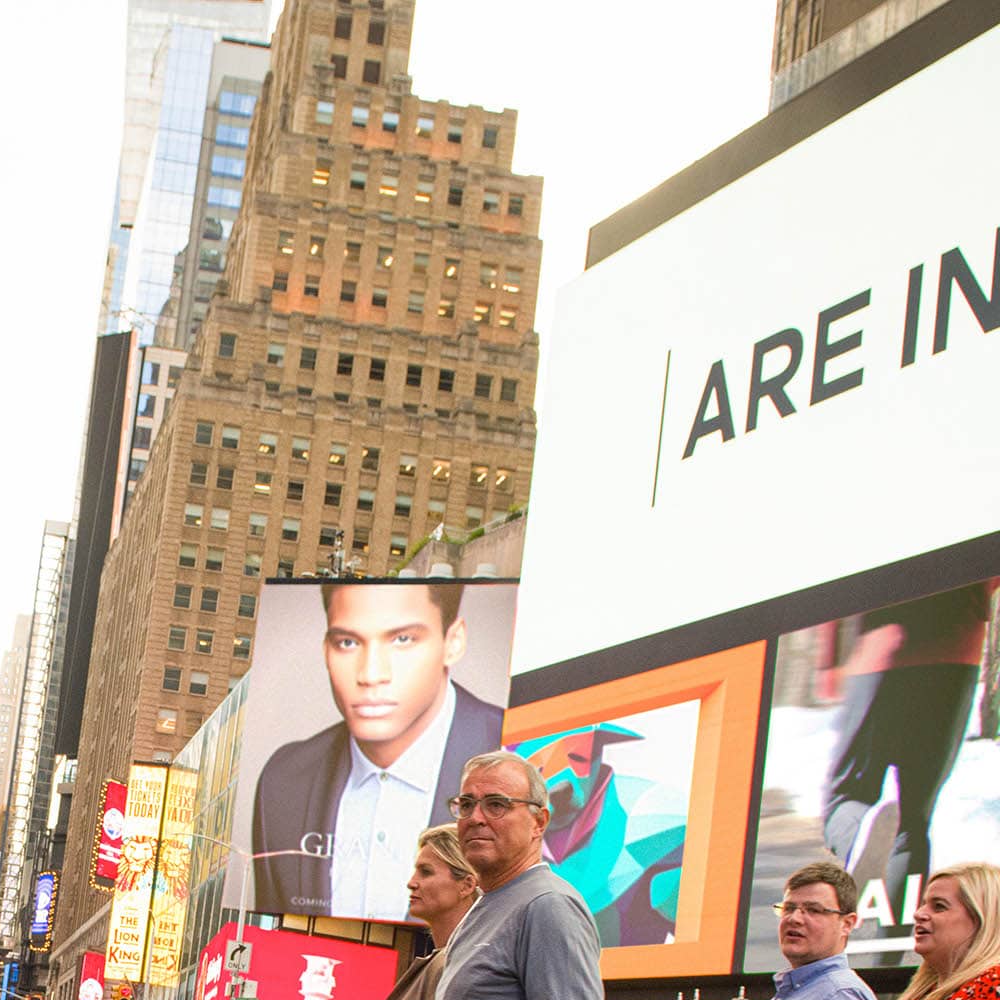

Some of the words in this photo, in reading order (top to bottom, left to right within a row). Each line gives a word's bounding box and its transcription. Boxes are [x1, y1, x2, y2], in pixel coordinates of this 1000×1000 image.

[681, 288, 872, 461] ARE
[128, 801, 160, 819] TODAY
[120, 915, 139, 926] THE
[113, 928, 140, 944] LION
[108, 945, 140, 964] KING
[227, 961, 248, 972] ONLY
